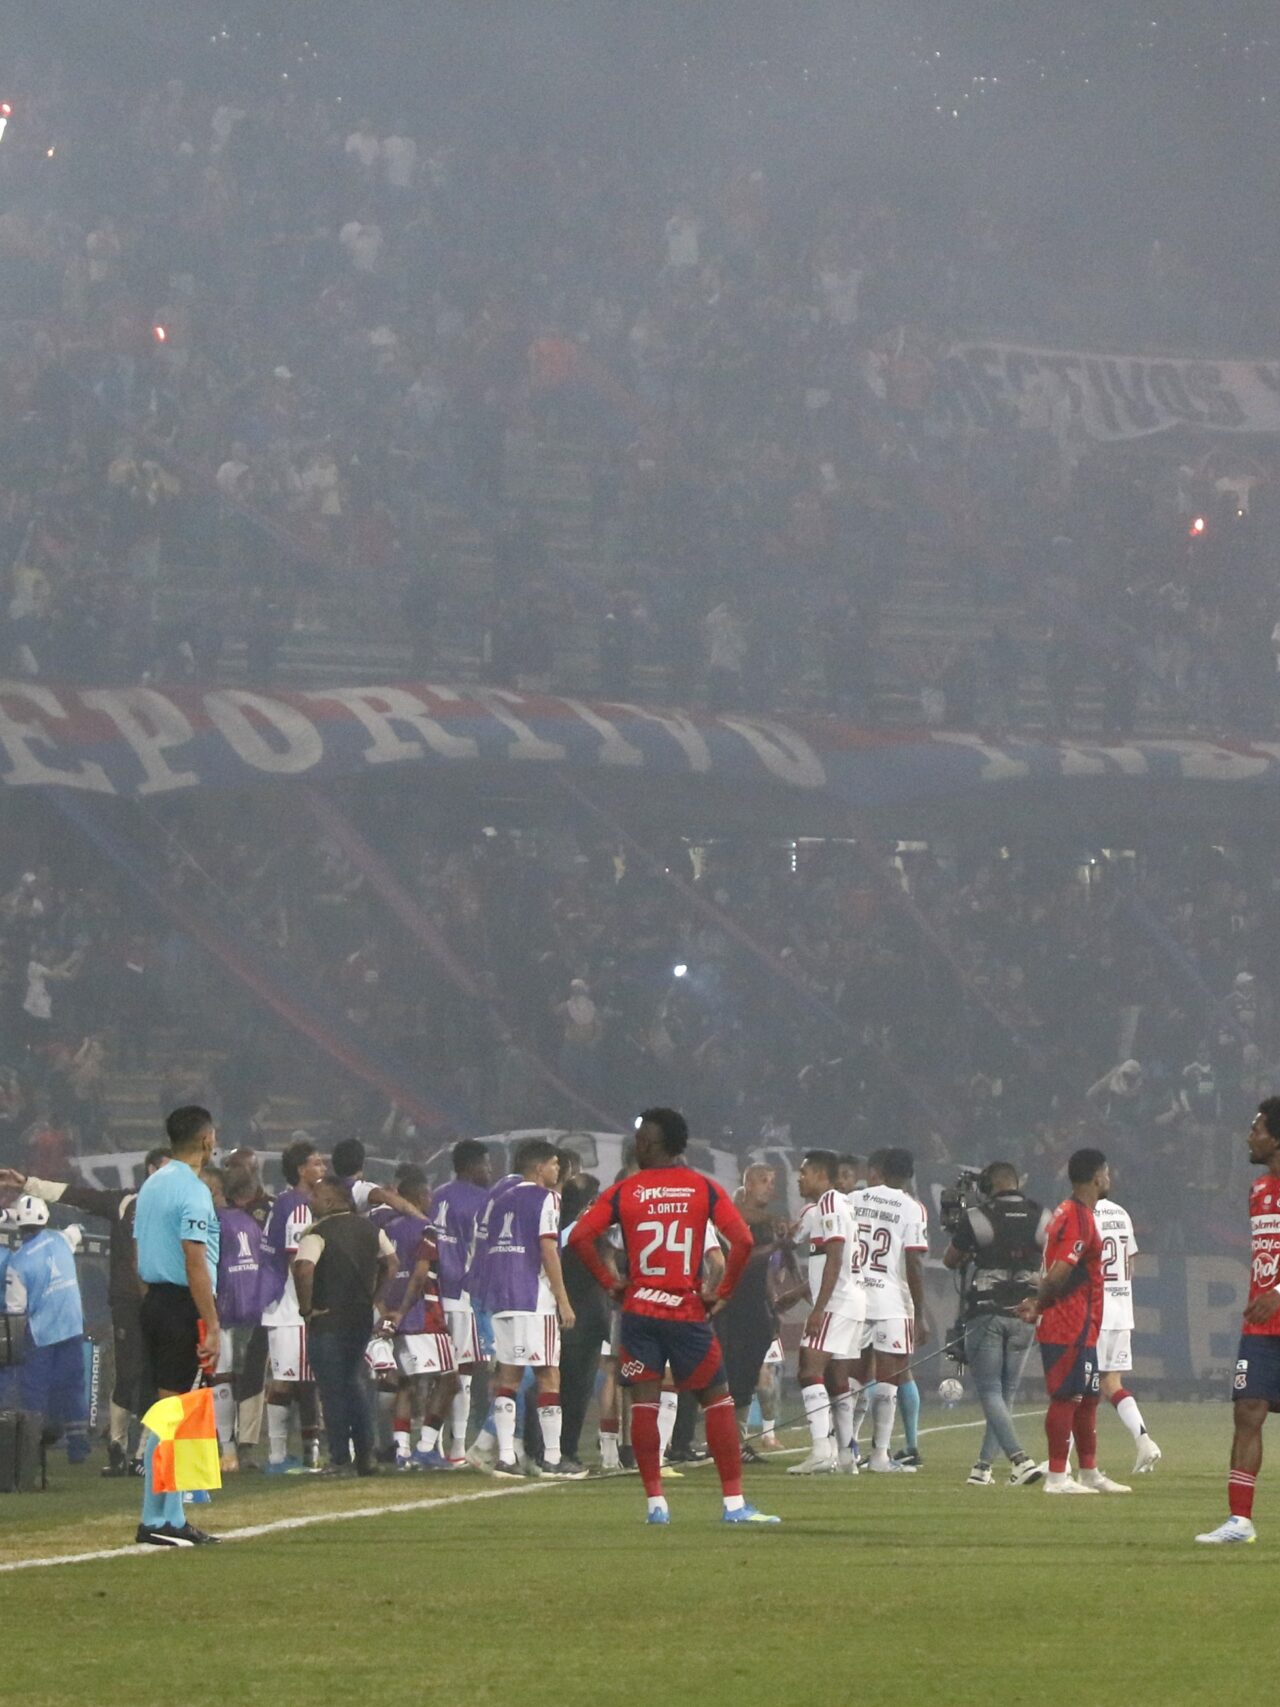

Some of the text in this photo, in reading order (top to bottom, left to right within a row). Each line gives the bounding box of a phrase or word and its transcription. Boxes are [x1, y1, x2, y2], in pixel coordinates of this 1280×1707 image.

[640, 1187, 662, 1203] JFK
[636, 1220, 693, 1275] 24
[857, 1223, 891, 1274] 52
[633, 1287, 684, 1307] MAPEI
[90, 1344, 101, 1427] POWERADE
